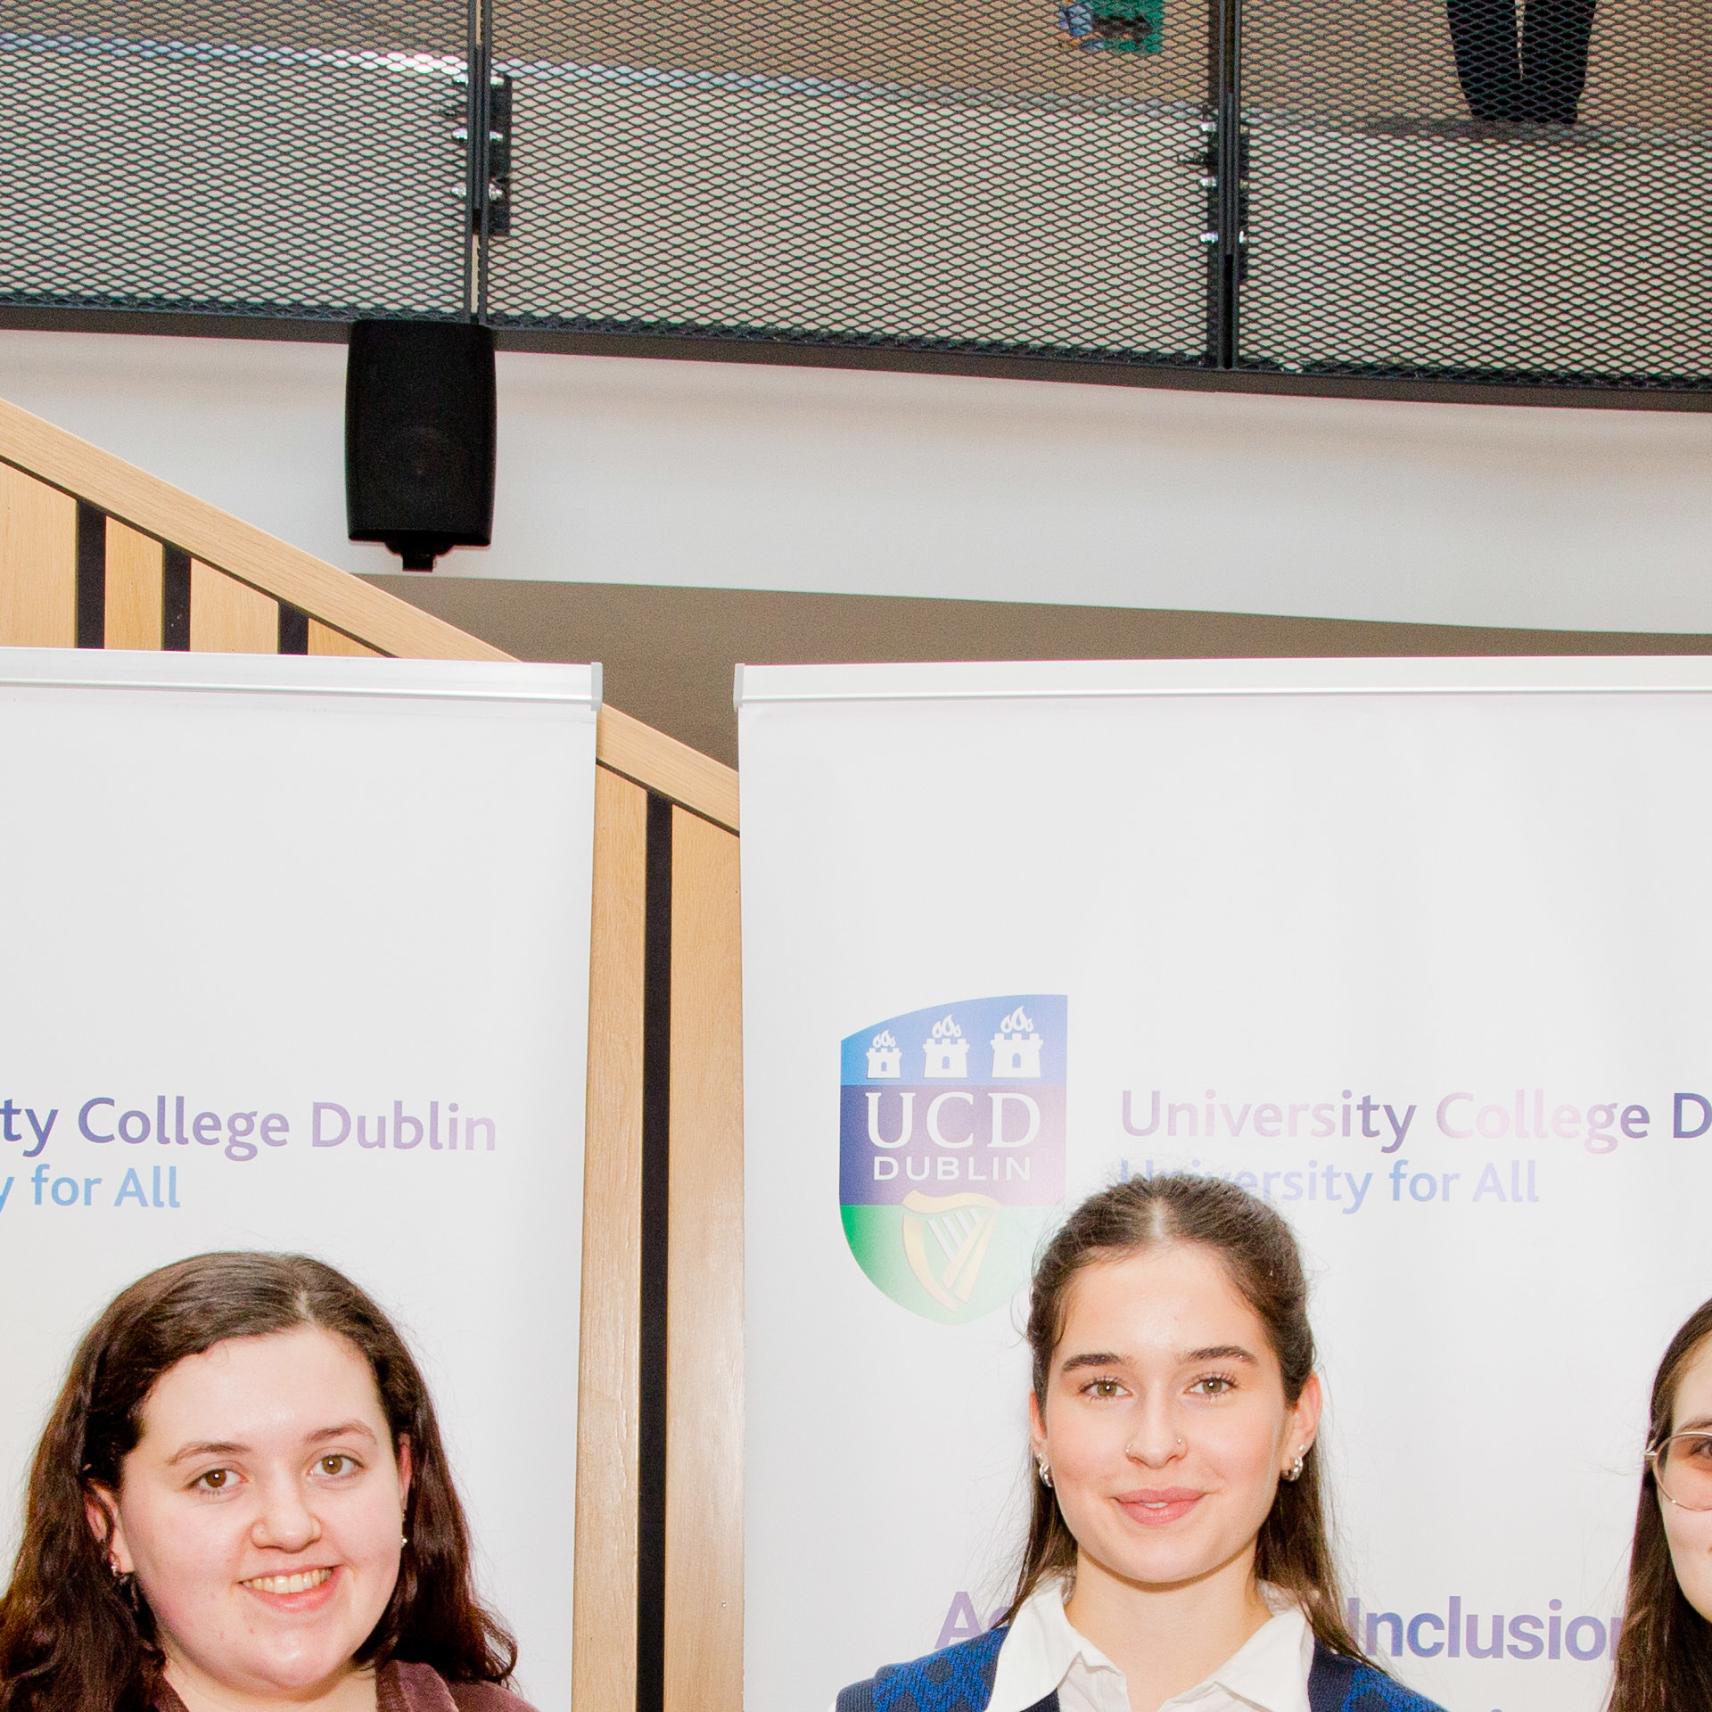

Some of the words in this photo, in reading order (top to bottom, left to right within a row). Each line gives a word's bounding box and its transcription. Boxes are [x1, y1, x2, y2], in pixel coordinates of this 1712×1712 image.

[78, 1095, 289, 1161] College
[310, 1099, 498, 1153] Dublin
[865, 1087, 1046, 1152] UCD
[1119, 1087, 1418, 1155] University
[1435, 1089, 1652, 1155] College
[31, 1165, 102, 1208] for
[114, 1165, 182, 1210] All
[871, 1153, 1033, 1183] DUBLIN
[1388, 1161, 1463, 1204] for
[1472, 1161, 1541, 1204] All
